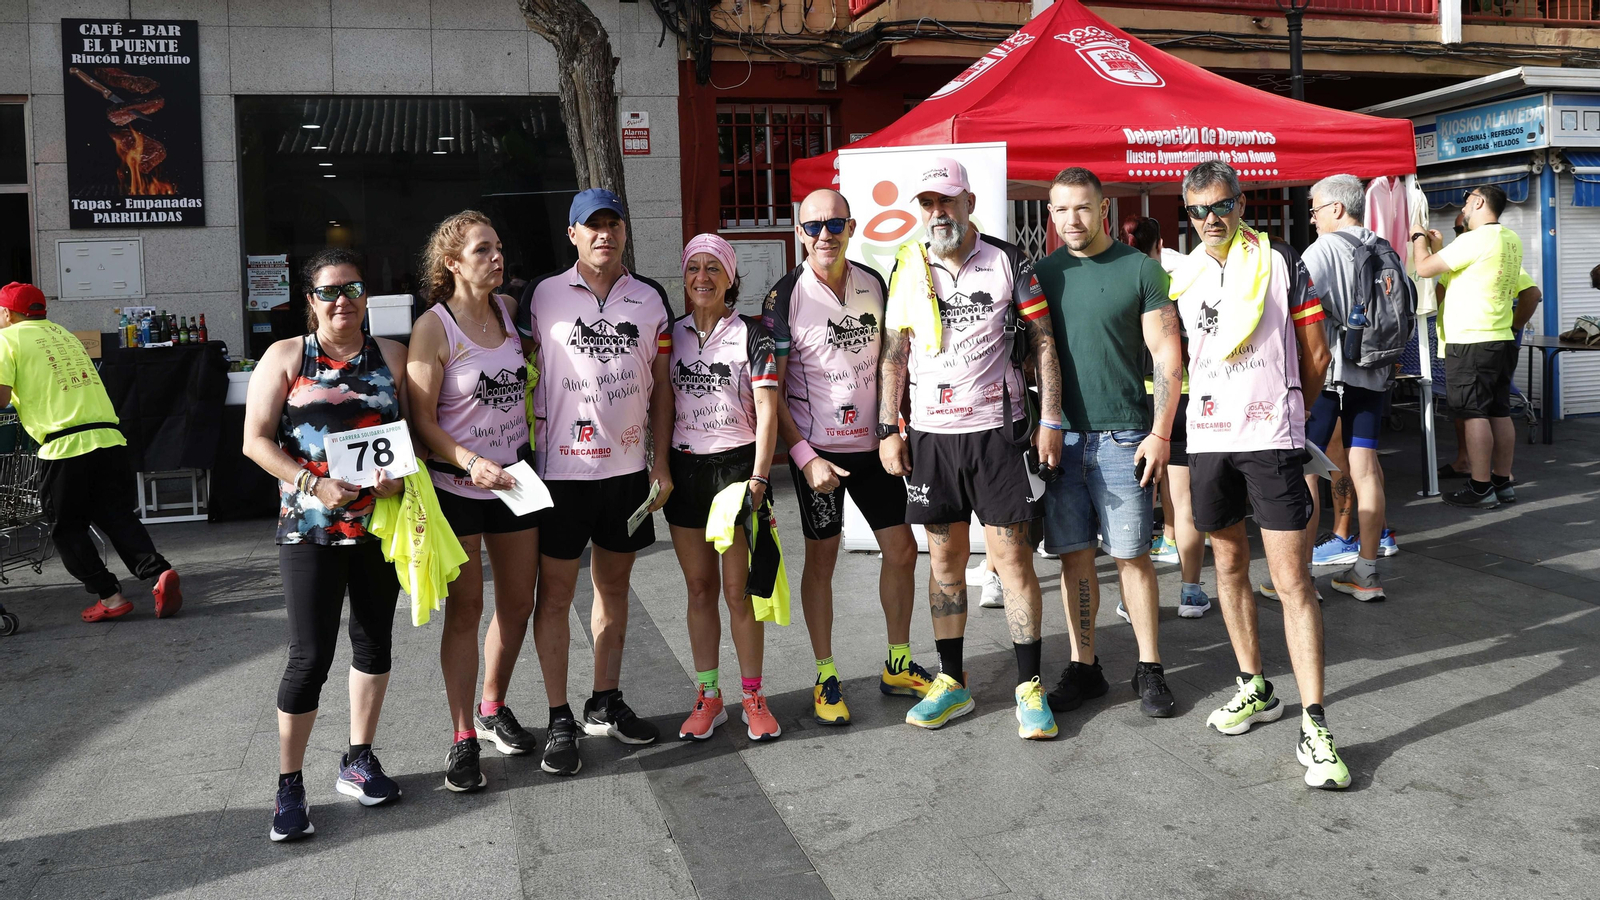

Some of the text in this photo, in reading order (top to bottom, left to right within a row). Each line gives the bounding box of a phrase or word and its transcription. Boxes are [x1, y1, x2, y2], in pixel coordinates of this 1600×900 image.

[79, 22, 123, 36] CAFÉ
[141, 24, 182, 37] BAR
[82, 38, 180, 53] EL PUENTE
[71, 53, 192, 66] Rincón Argentino
[1441, 105, 1543, 138] KIOSKO ALAMEDA
[1122, 126, 1277, 147] Delegación de Deportes
[1456, 133, 1487, 144] GOLOSINAS
[1490, 126, 1524, 140] REFRESCOS
[1460, 142, 1490, 154] RECARGAS
[1493, 137, 1520, 150] HELADOS
[1126, 149, 1276, 165] Ilustre Ayuntamiento de San Roque
[71, 198, 112, 211] Tapas
[124, 197, 203, 210] Empanadas
[93, 211, 183, 223] PARRILLADAS
[834, 336, 876, 350] TRAIL
[576, 346, 631, 355] TRAIL
[1224, 357, 1267, 380] pasión
[823, 370, 850, 383] Una
[562, 377, 590, 392] Una
[677, 384, 722, 392] TRAIL
[847, 378, 860, 391] mi
[480, 393, 524, 405] TRAIL
[584, 384, 640, 406] mi pasión
[935, 407, 973, 415] RECAMBIO
[703, 416, 740, 432] pasión
[1196, 421, 1232, 430] RECAMBIO
[338, 433, 361, 443] CARRERA
[361, 429, 385, 439] SOLIDARIA
[470, 426, 496, 438] Una
[836, 426, 869, 437] RECAMBIO
[489, 440, 502, 448] mi
[347, 437, 395, 473] 78
[570, 447, 612, 456] RECAMBIO
